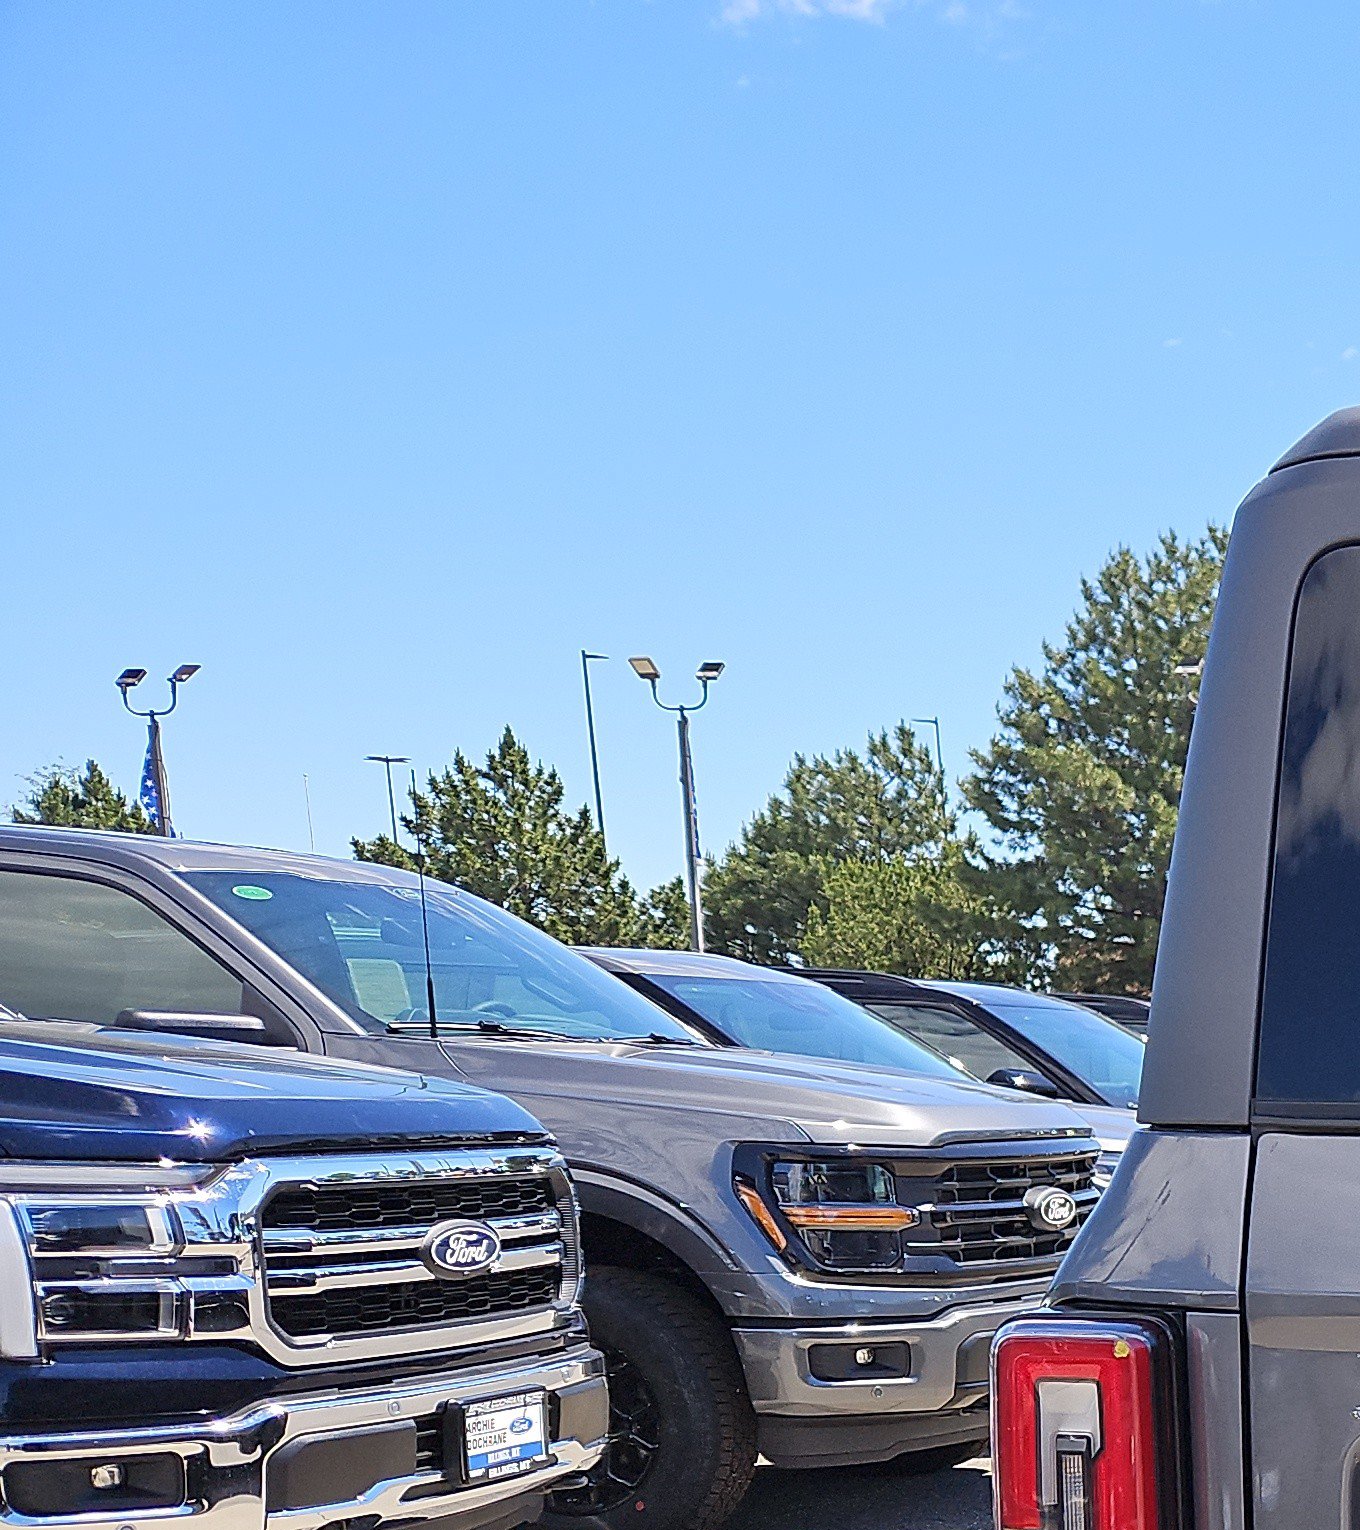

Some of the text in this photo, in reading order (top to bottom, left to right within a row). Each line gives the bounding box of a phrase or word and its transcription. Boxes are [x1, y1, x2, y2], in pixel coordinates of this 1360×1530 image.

[1048, 1198, 1070, 1219] Ford
[445, 1233, 489, 1264] Ford
[466, 1418, 496, 1434] ARCHIE
[466, 1432, 507, 1451] COCHRANE
